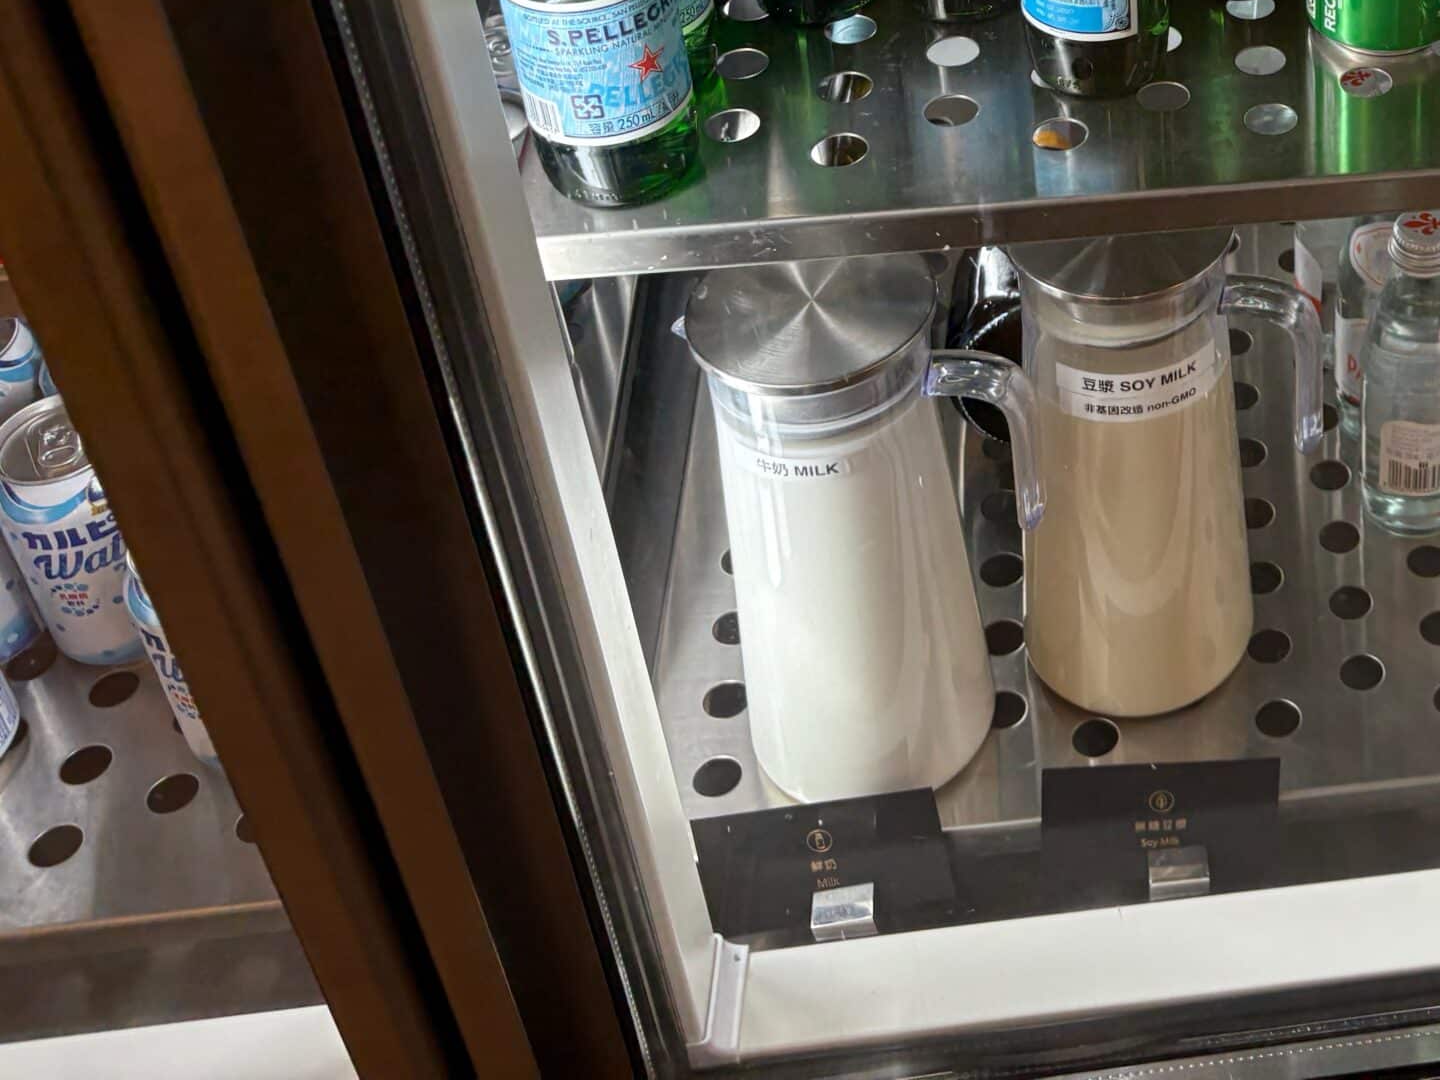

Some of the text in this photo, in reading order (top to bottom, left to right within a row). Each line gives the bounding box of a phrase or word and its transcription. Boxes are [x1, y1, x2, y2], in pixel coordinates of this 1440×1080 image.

[555, 43, 609, 56] SPARKLING
[1120, 377, 1156, 392] SOY
[1160, 360, 1196, 386] MILK
[1085, 387, 1196, 415] 非基因改造 non-GMO
[794, 462, 839, 476] MILK
[816, 877, 840, 888] Milk
